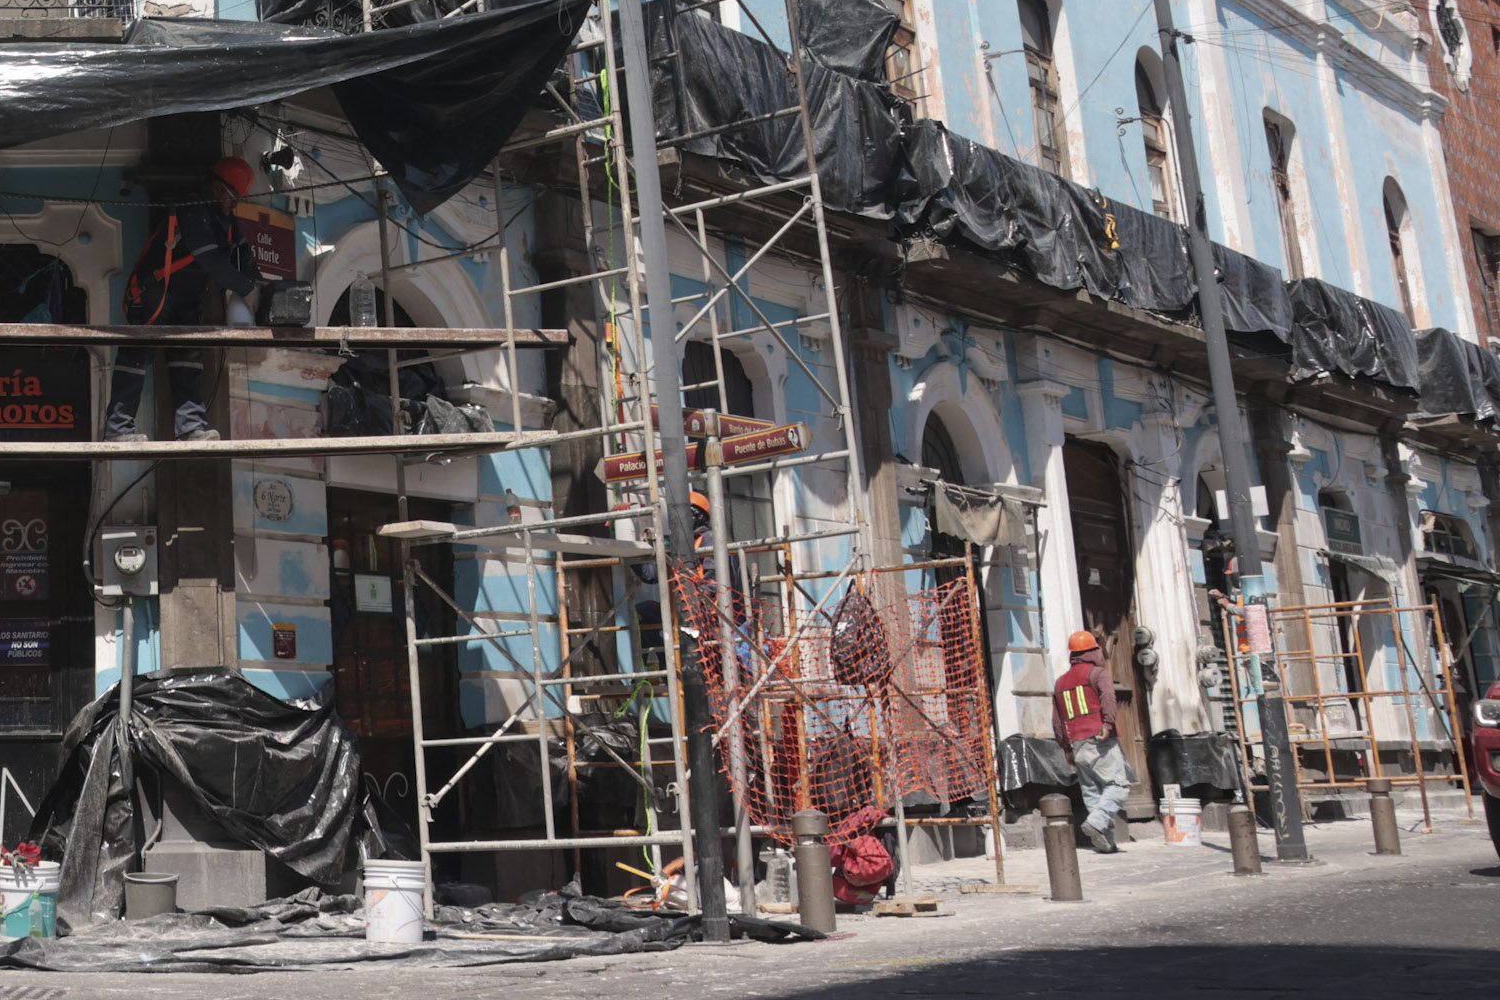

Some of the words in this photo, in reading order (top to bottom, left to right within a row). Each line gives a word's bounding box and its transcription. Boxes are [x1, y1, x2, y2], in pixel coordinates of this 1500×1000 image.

[257, 232, 272, 246] Calle
[258, 247, 280, 264] Norte
[734, 441, 756, 455] Puente
[757, 439, 765, 450] de
[766, 436, 786, 448] Bubas
[619, 461, 646, 472] Palacio
[11, 640, 22, 649] NO
[23, 640, 38, 649] SON
[7, 648, 42, 658] PÚBLICOS
